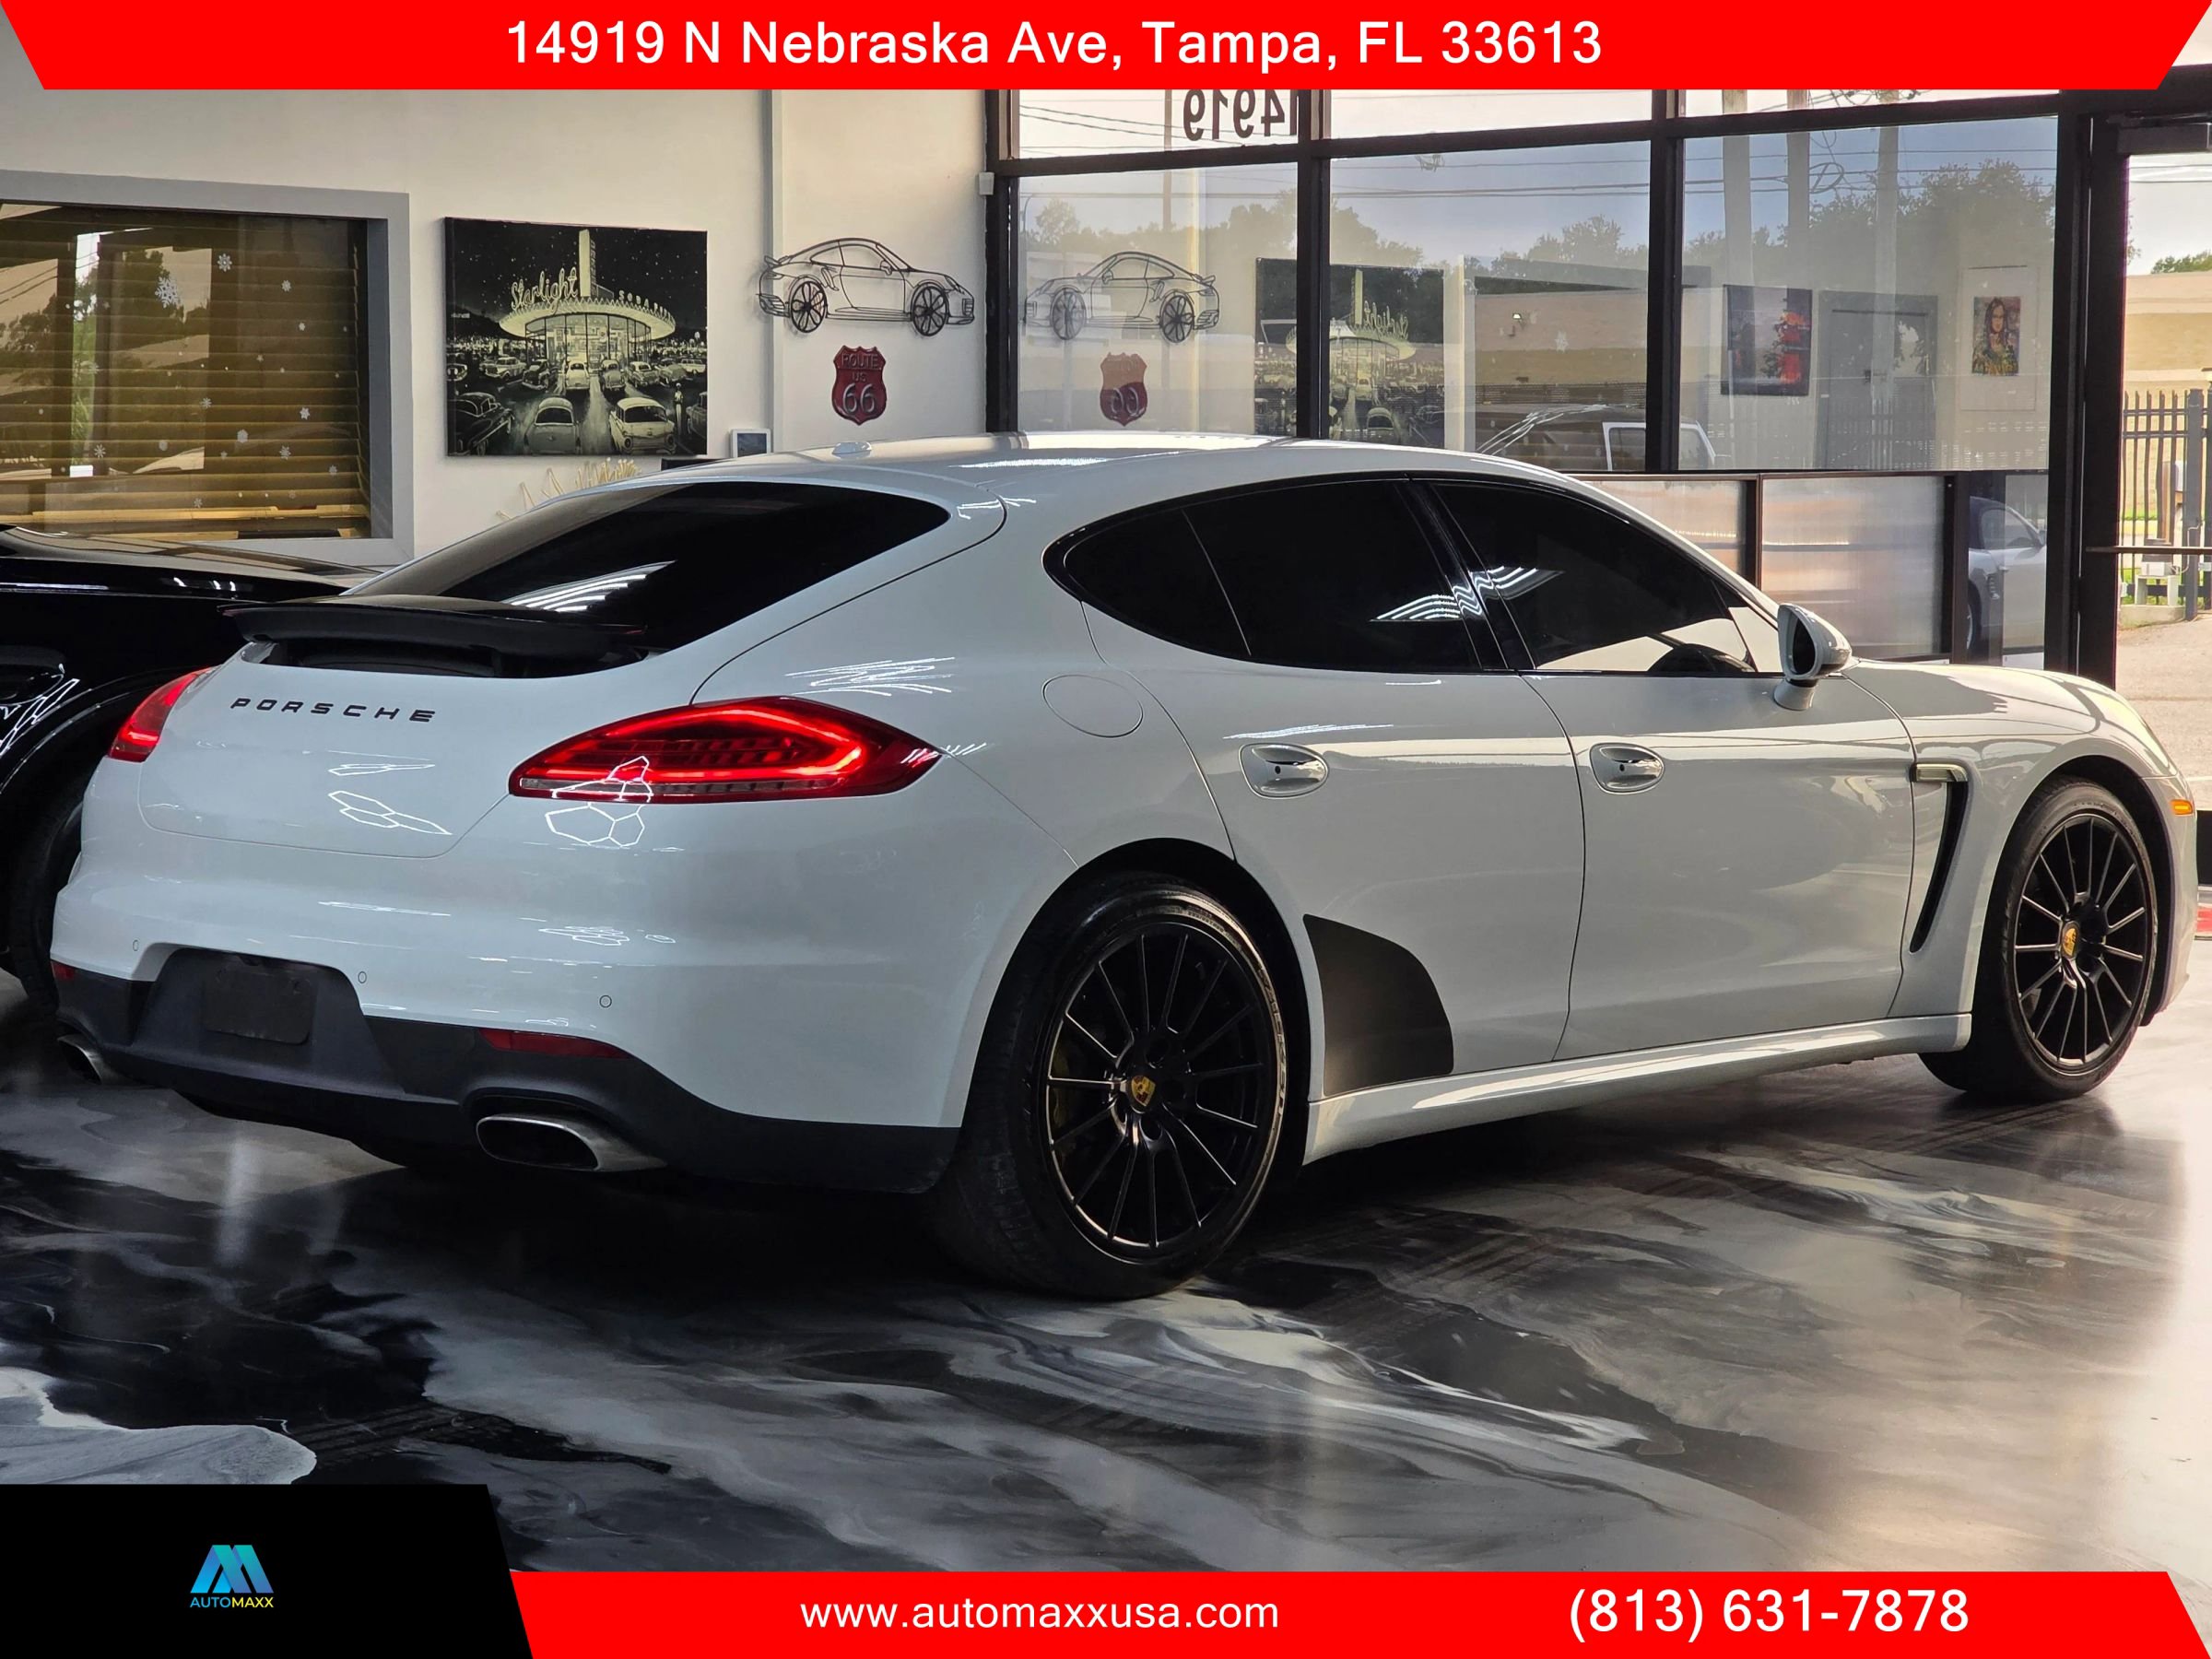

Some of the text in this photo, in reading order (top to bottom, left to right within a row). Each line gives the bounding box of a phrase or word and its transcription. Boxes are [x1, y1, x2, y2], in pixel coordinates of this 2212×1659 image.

[511, 266, 579, 315] Starlight
[841, 353, 879, 369] ROUTE
[852, 371, 867, 382] US
[842, 382, 876, 415] 66
[229, 697, 436, 723] PORSCHE
